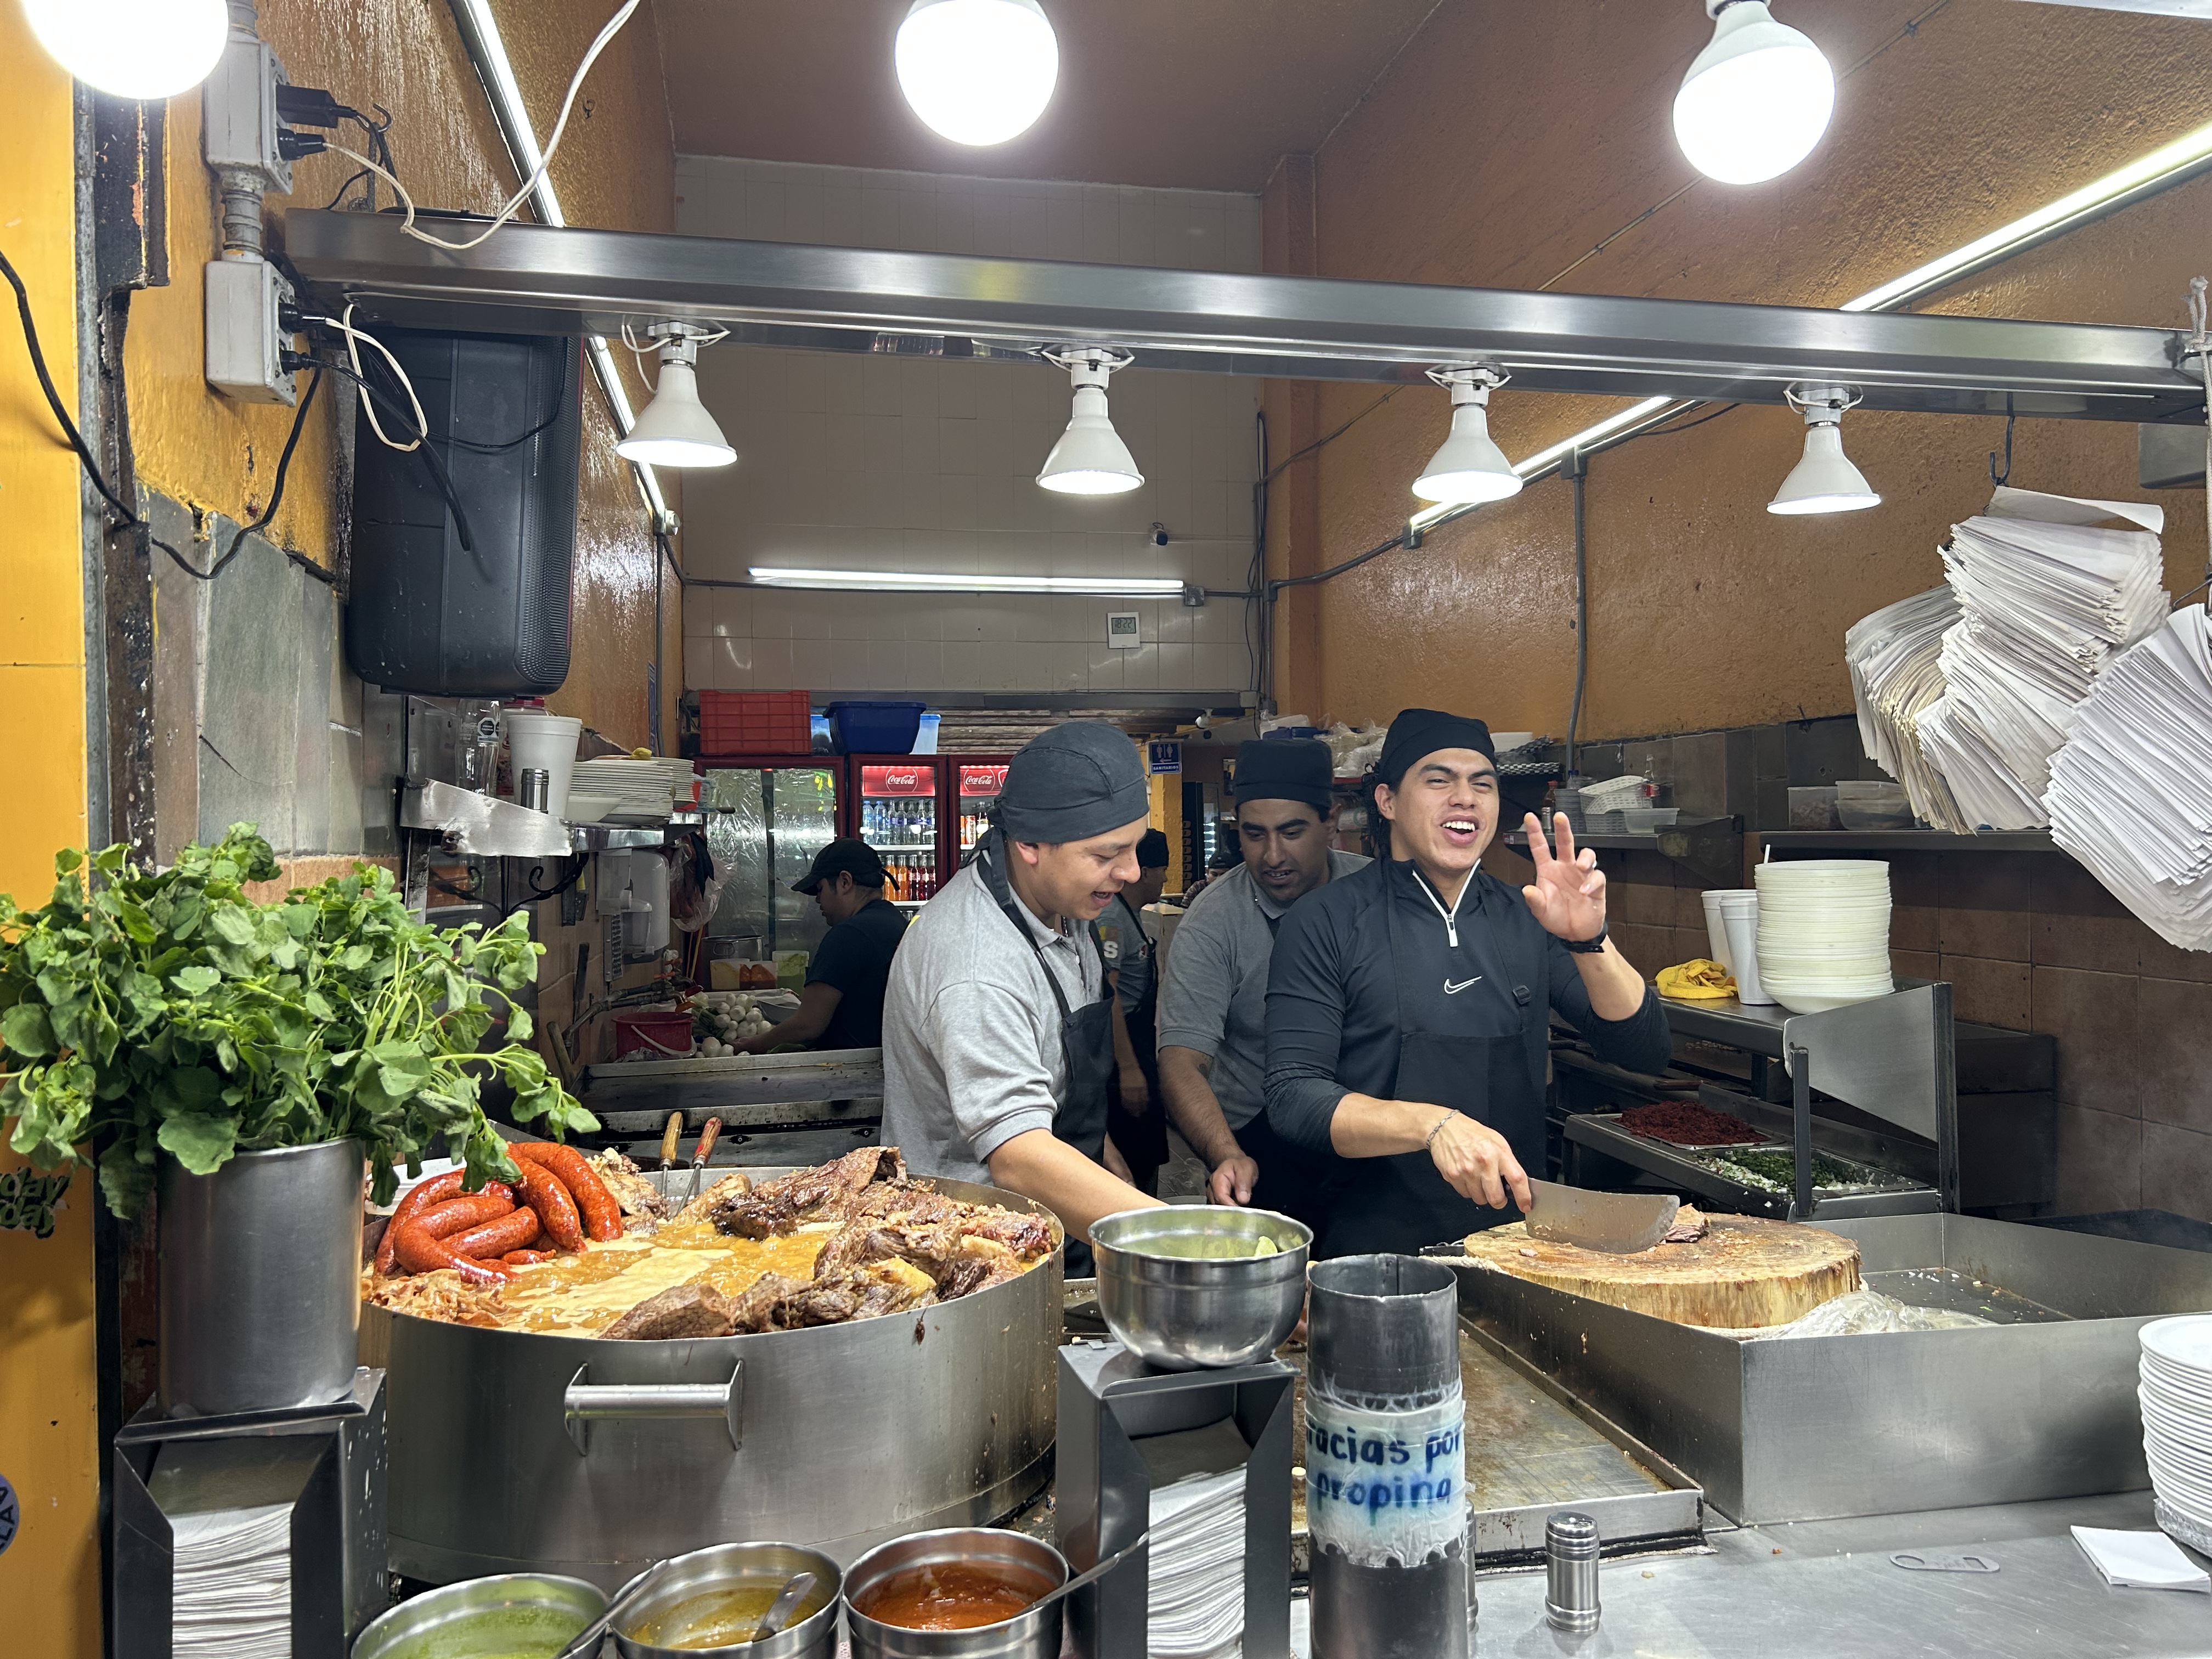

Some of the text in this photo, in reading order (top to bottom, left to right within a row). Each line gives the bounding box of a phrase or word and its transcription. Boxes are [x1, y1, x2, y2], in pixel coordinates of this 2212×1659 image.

[887, 775, 916, 785] Coca-Cola
[965, 775, 993, 785] Coca-Cola
[1306, 1420, 1410, 1465] racias
[1317, 1472, 1452, 1525] propina
